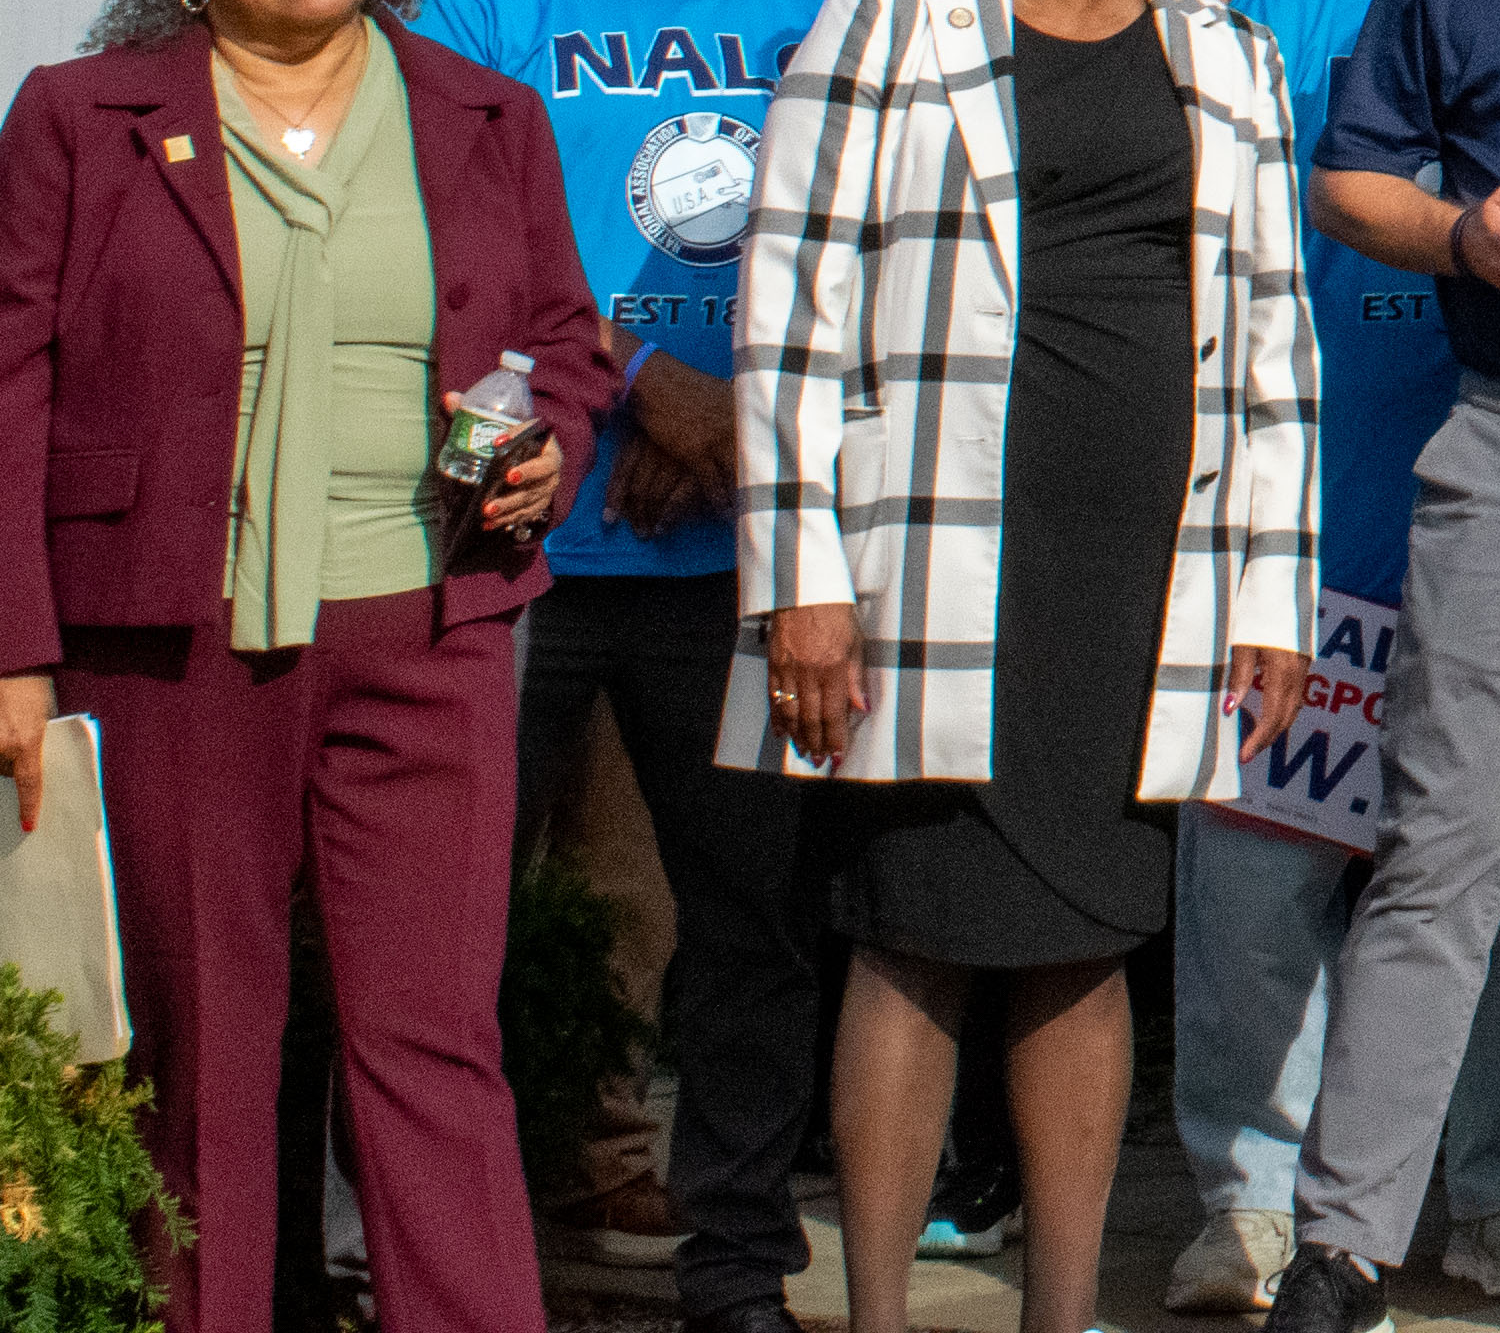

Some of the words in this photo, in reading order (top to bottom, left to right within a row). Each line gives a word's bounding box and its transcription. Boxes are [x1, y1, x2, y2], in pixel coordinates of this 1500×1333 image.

[632, 123, 680, 196] ASSOCIATION
[635, 198, 682, 254] NATIONAL
[609, 293, 688, 326] EST
[1361, 291, 1433, 323] EST
